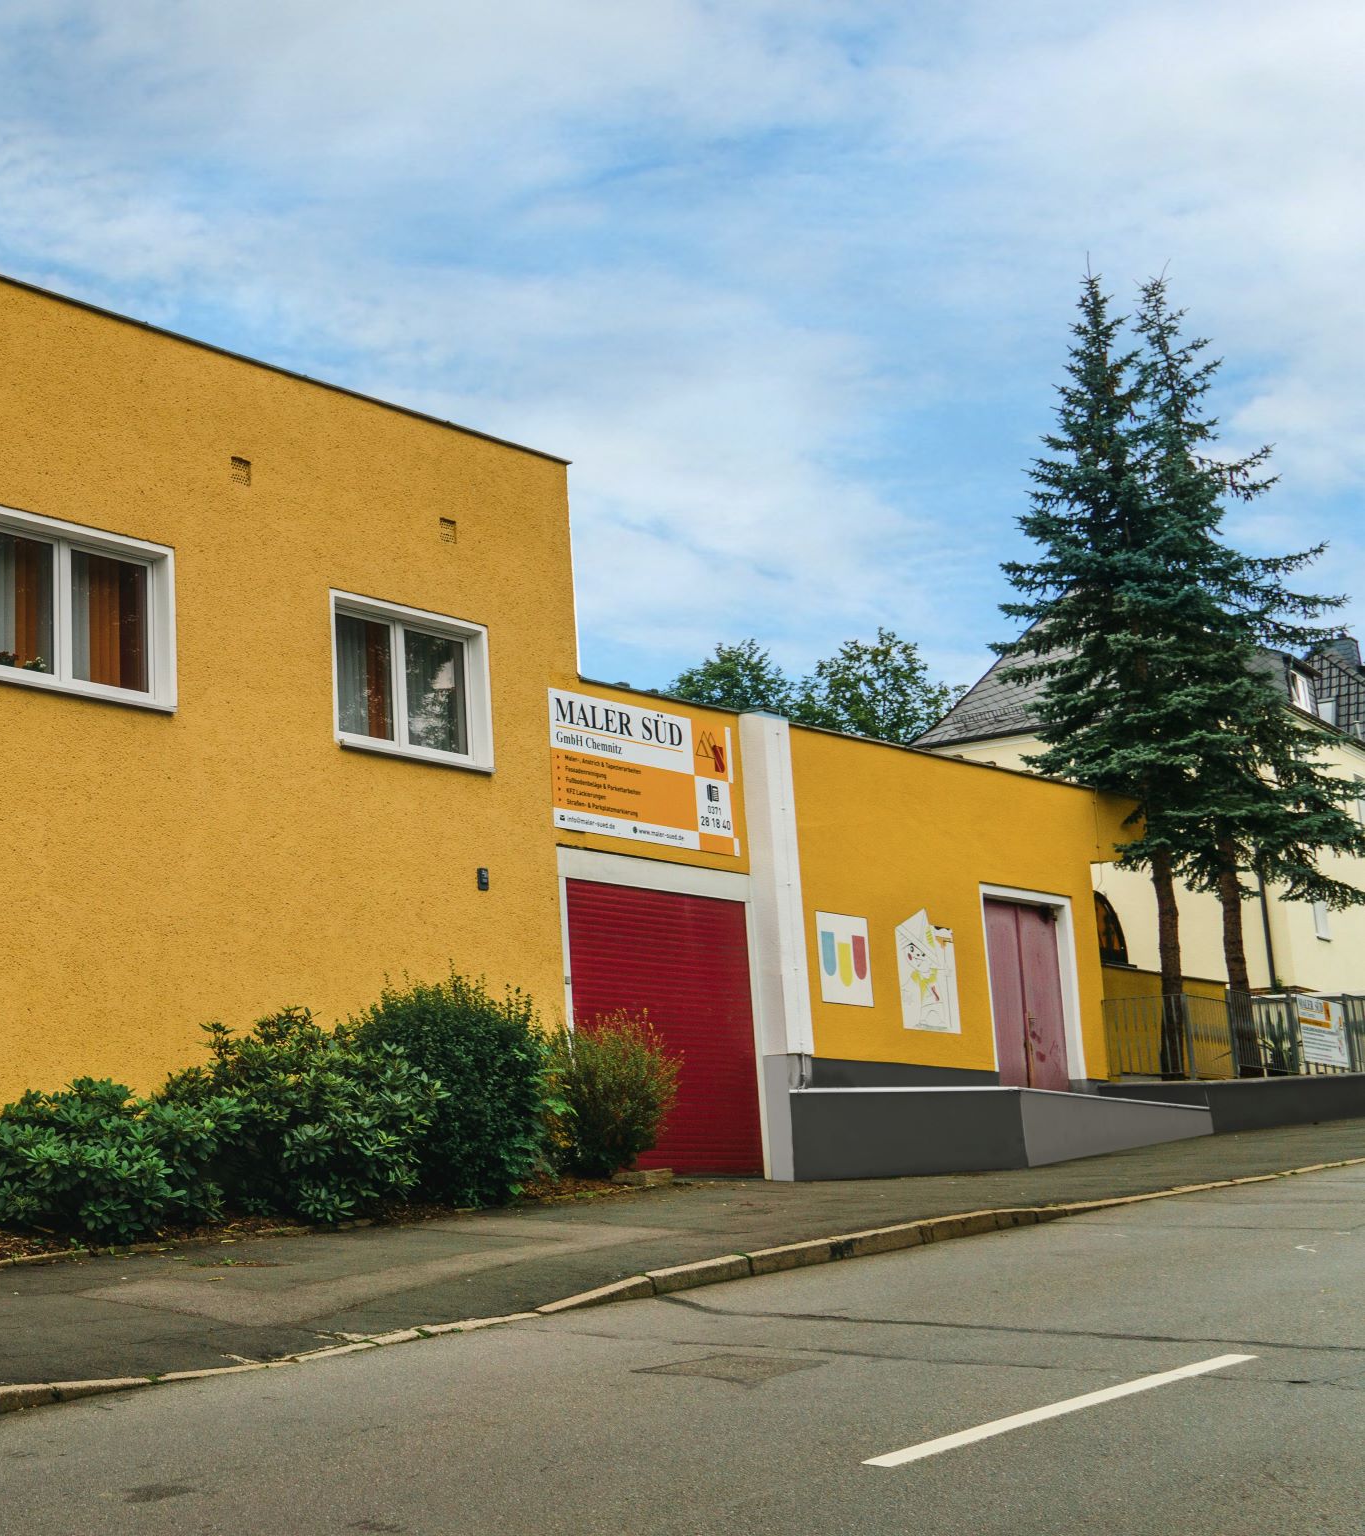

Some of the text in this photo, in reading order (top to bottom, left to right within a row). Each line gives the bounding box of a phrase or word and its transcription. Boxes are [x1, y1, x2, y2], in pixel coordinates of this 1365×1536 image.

[555, 697, 683, 747] MALER SÜD
[556, 731, 623, 755] GmbH Chemnitz
[707, 805, 722, 816] 0371
[700, 815, 731, 831] 28 18 40
